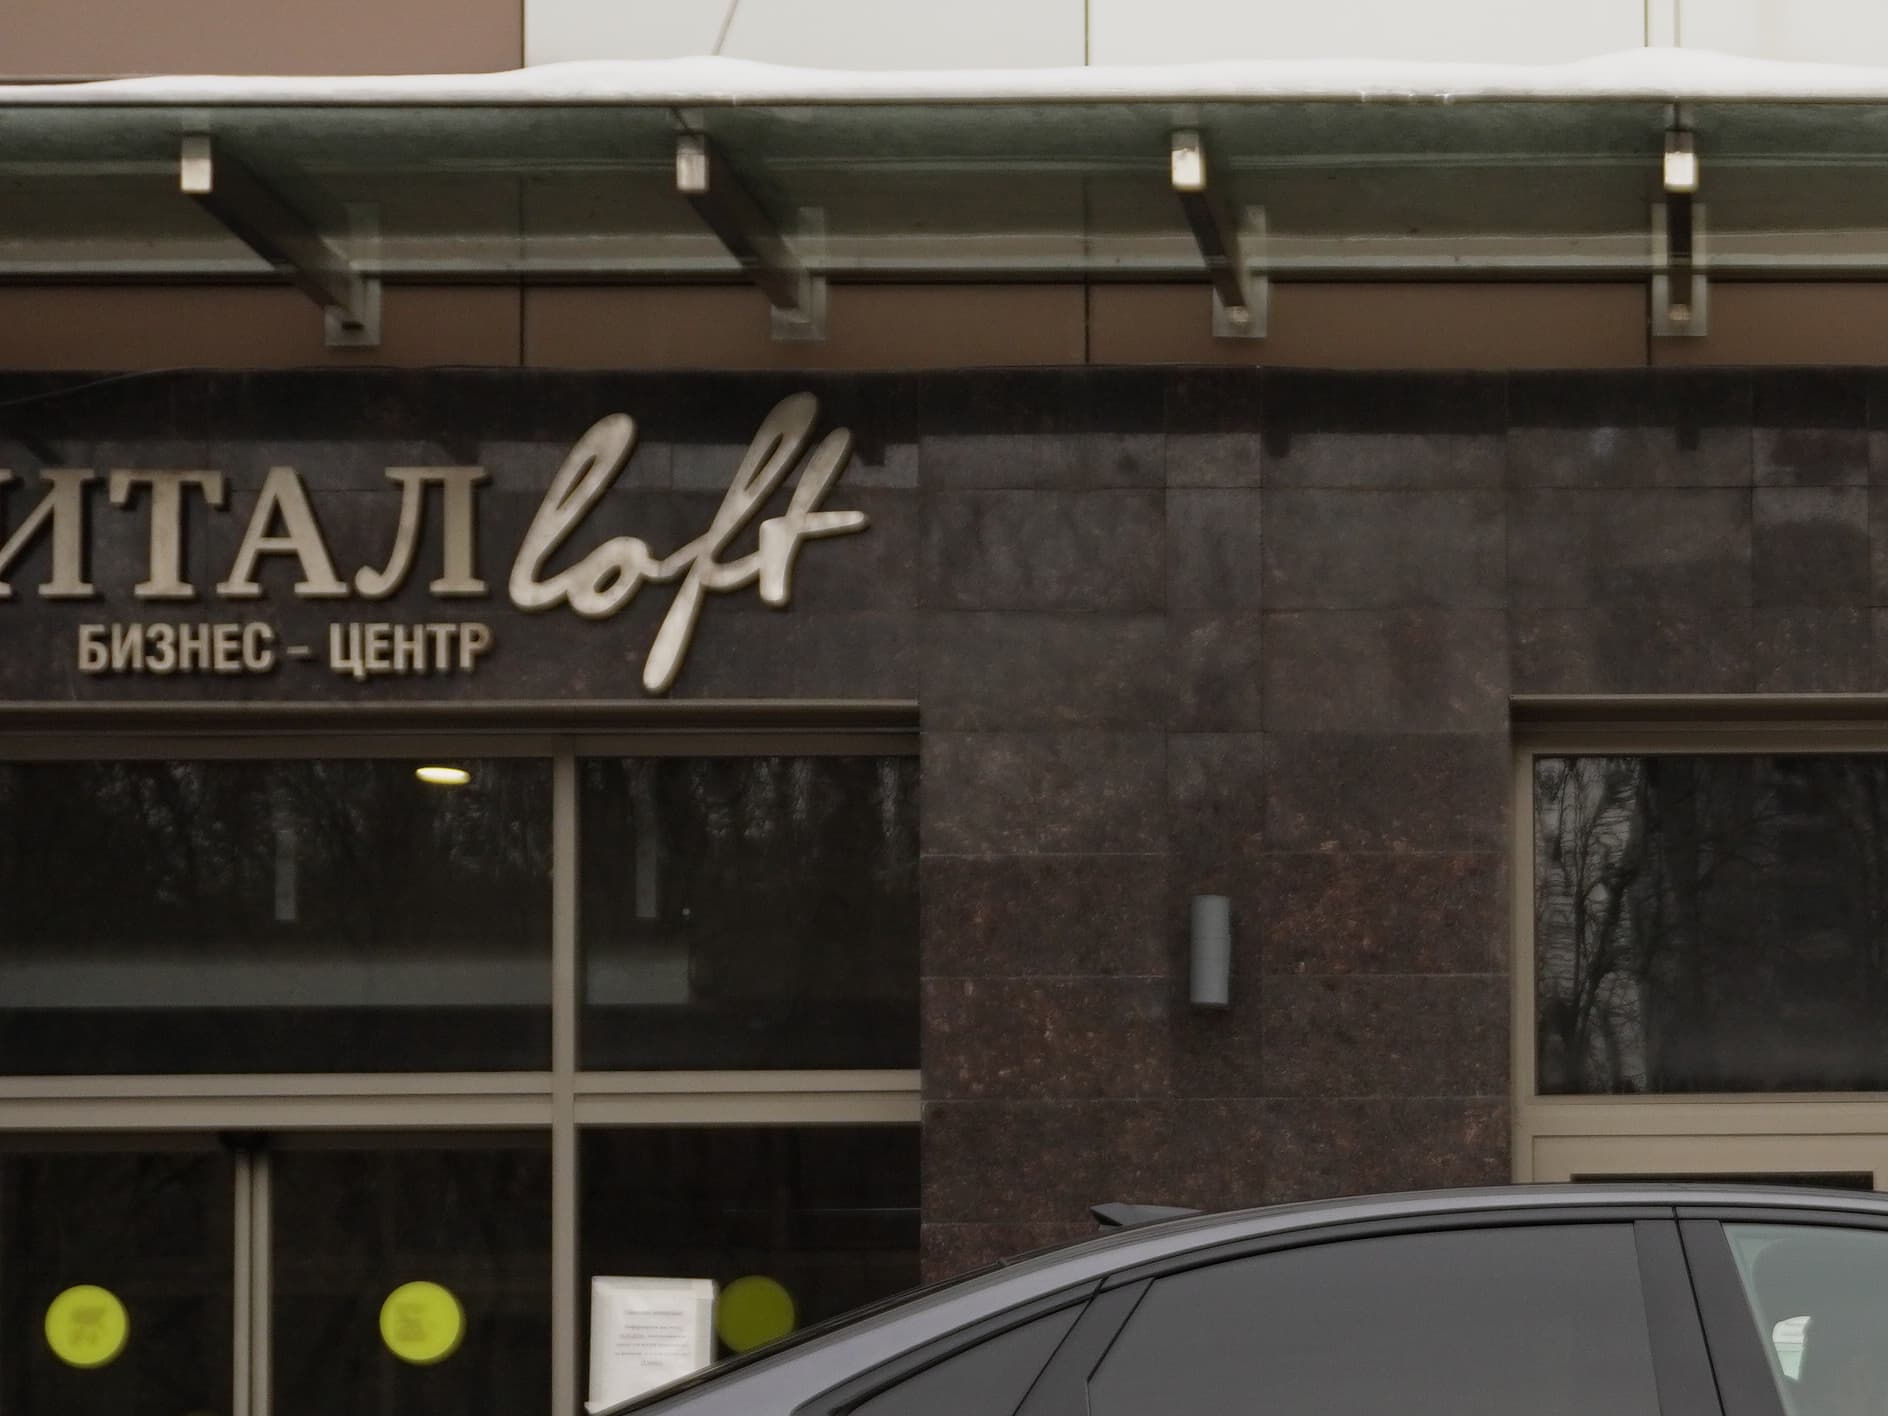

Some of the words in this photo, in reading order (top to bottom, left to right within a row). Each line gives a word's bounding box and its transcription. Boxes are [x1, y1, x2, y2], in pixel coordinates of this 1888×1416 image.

[509, 391, 870, 693] loft
[78, 622, 275, 673] БИЗНЕС
[329, 621, 493, 679] ЦЕНТР
